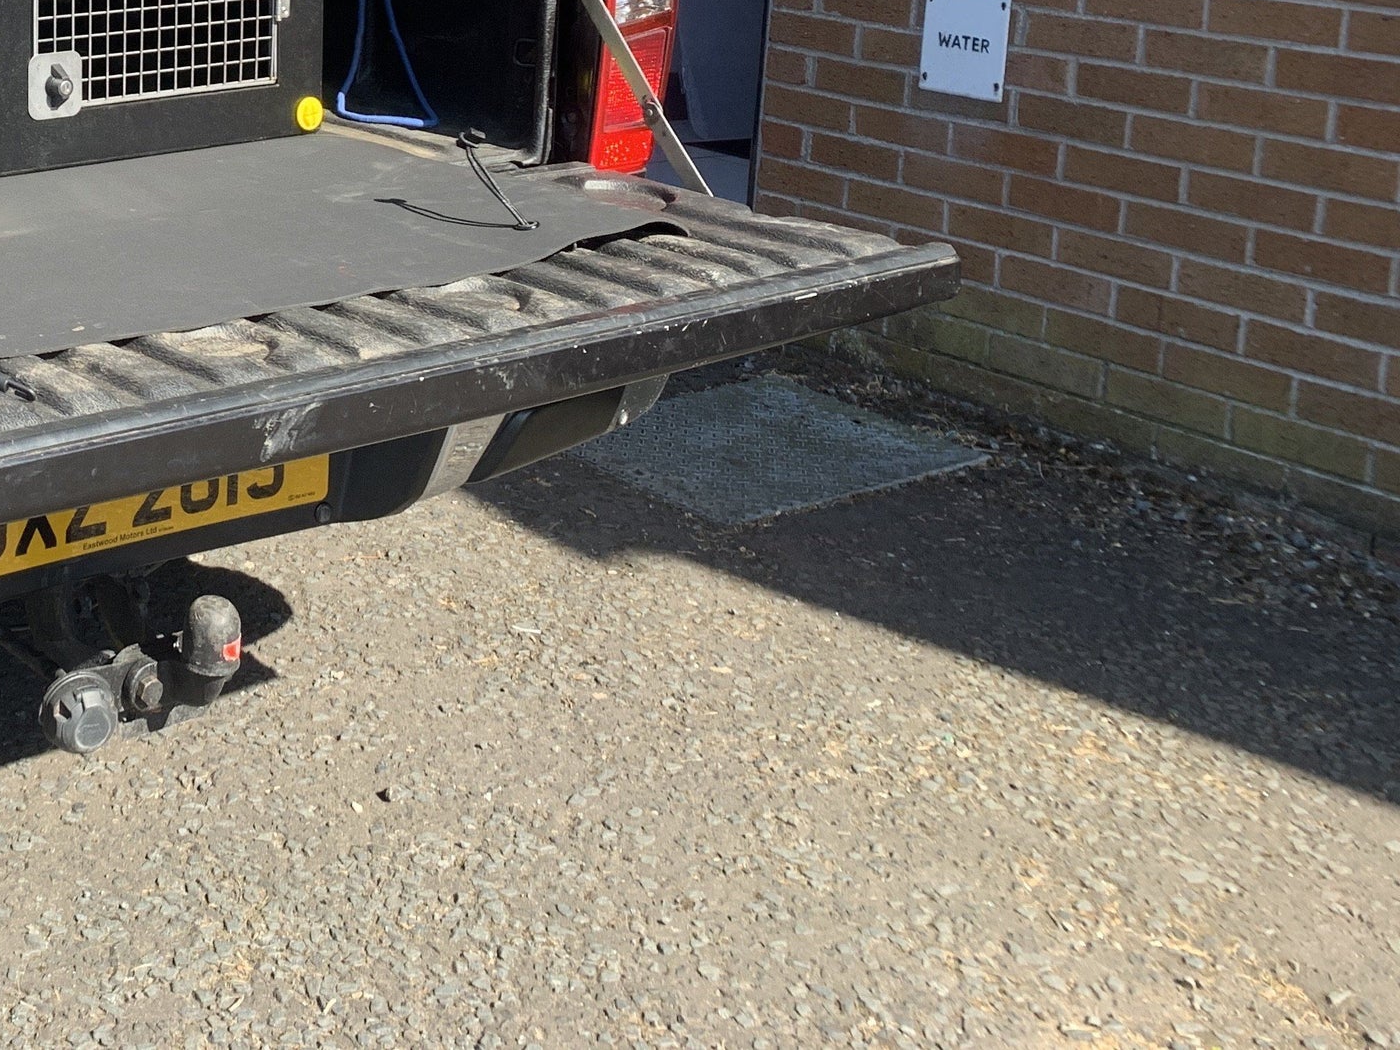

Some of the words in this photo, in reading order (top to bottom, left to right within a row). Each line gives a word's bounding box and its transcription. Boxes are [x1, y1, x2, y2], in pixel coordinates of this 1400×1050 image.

[939, 32, 990, 54] WATER
[82, 535, 118, 551] Eastwood
[119, 531, 144, 542] Motors
[145, 526, 158, 535] Ltd
